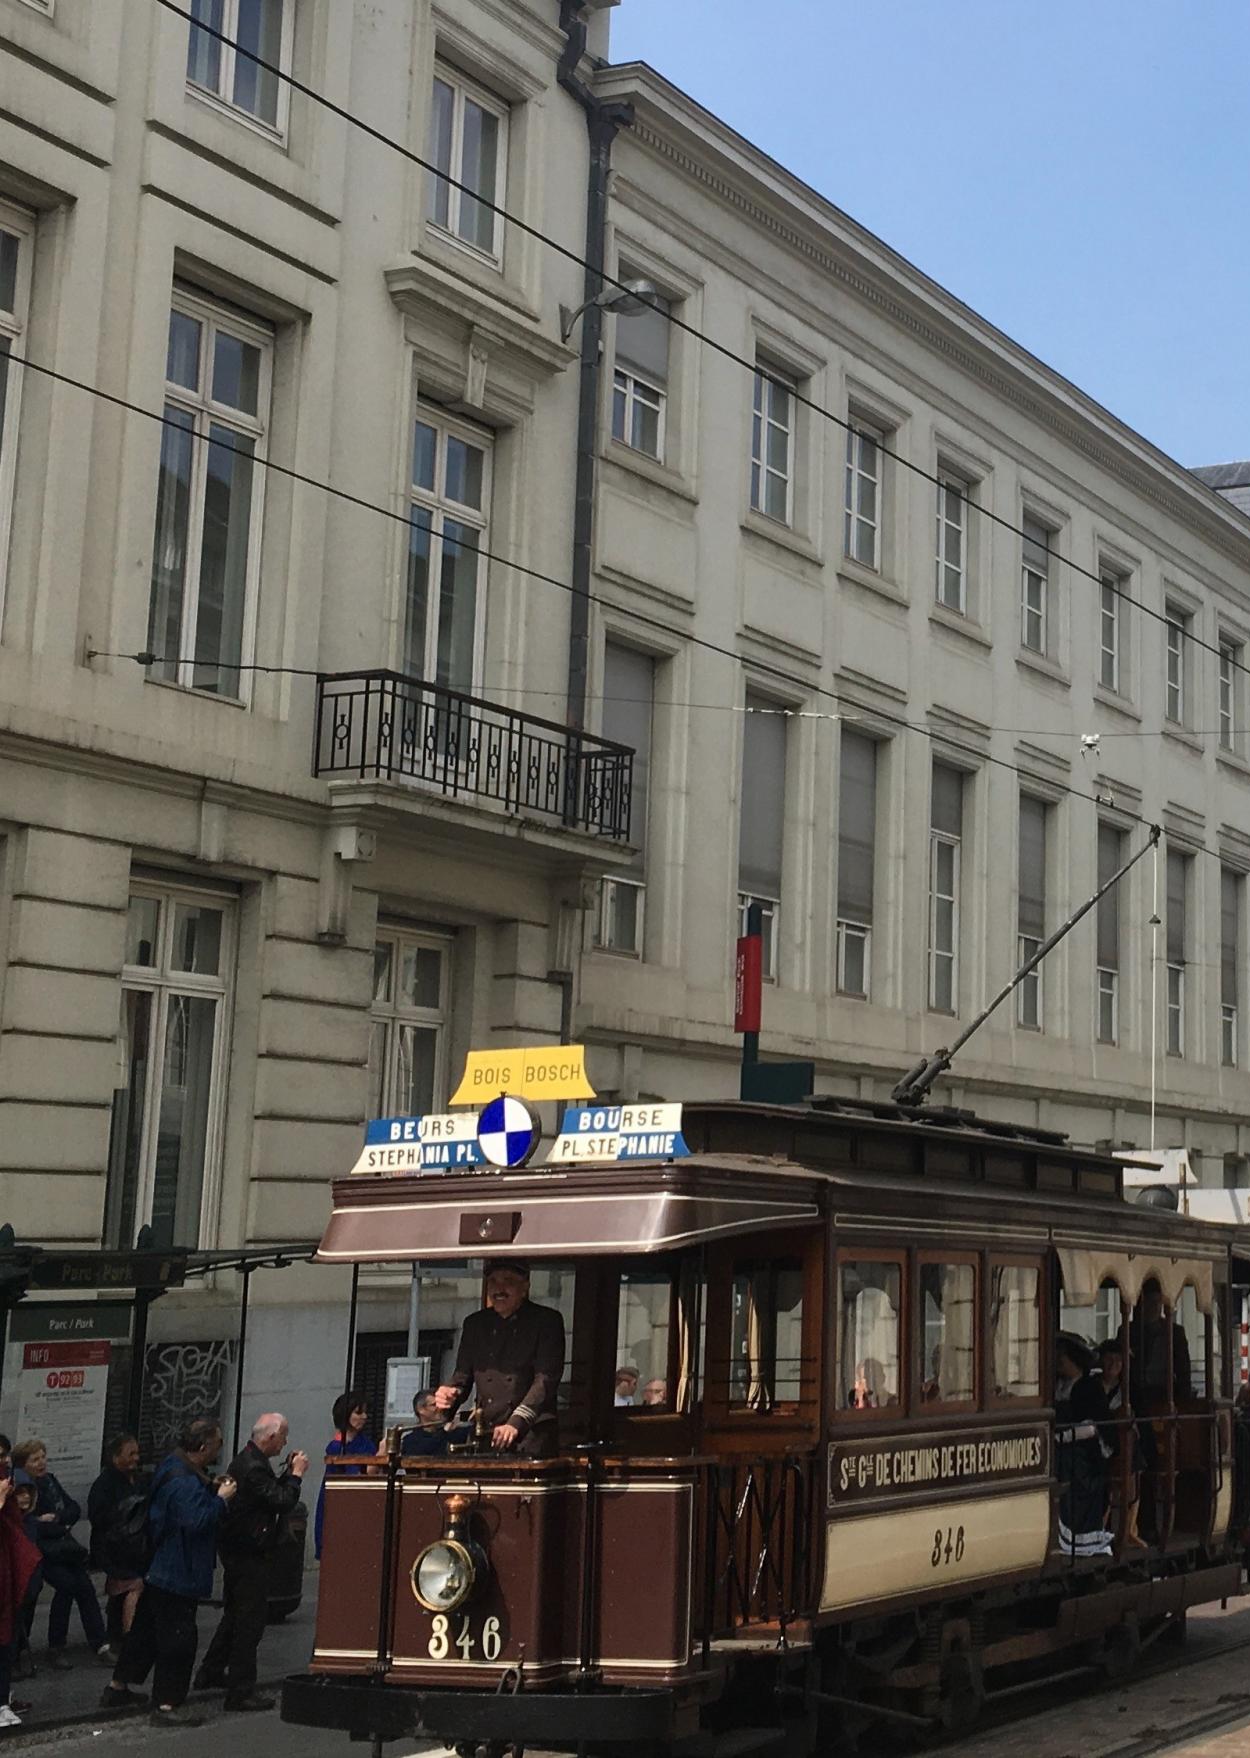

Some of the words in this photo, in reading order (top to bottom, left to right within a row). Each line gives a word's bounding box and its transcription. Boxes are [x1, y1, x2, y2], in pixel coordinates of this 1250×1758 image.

[473, 1067, 512, 1086] BOIS
[525, 1063, 581, 1083] BOSCH
[390, 1119, 455, 1141] BEURS
[578, 1109, 664, 1131] BOURSE
[368, 1144, 450, 1167] STEPHANIA
[456, 1143, 479, 1163] PL.
[587, 1134, 676, 1156] STEPHANIE
[50, 1319, 67, 1330] Parc
[75, 1318, 95, 1329] Park
[30, 1349, 50, 1363] INFO
[875, 1452, 892, 1487] DE
[893, 1447, 940, 1483] CHEMINS
[941, 1445, 955, 1478] DE
[956, 1442, 977, 1476] FER
[428, 1614, 501, 1660] 346
